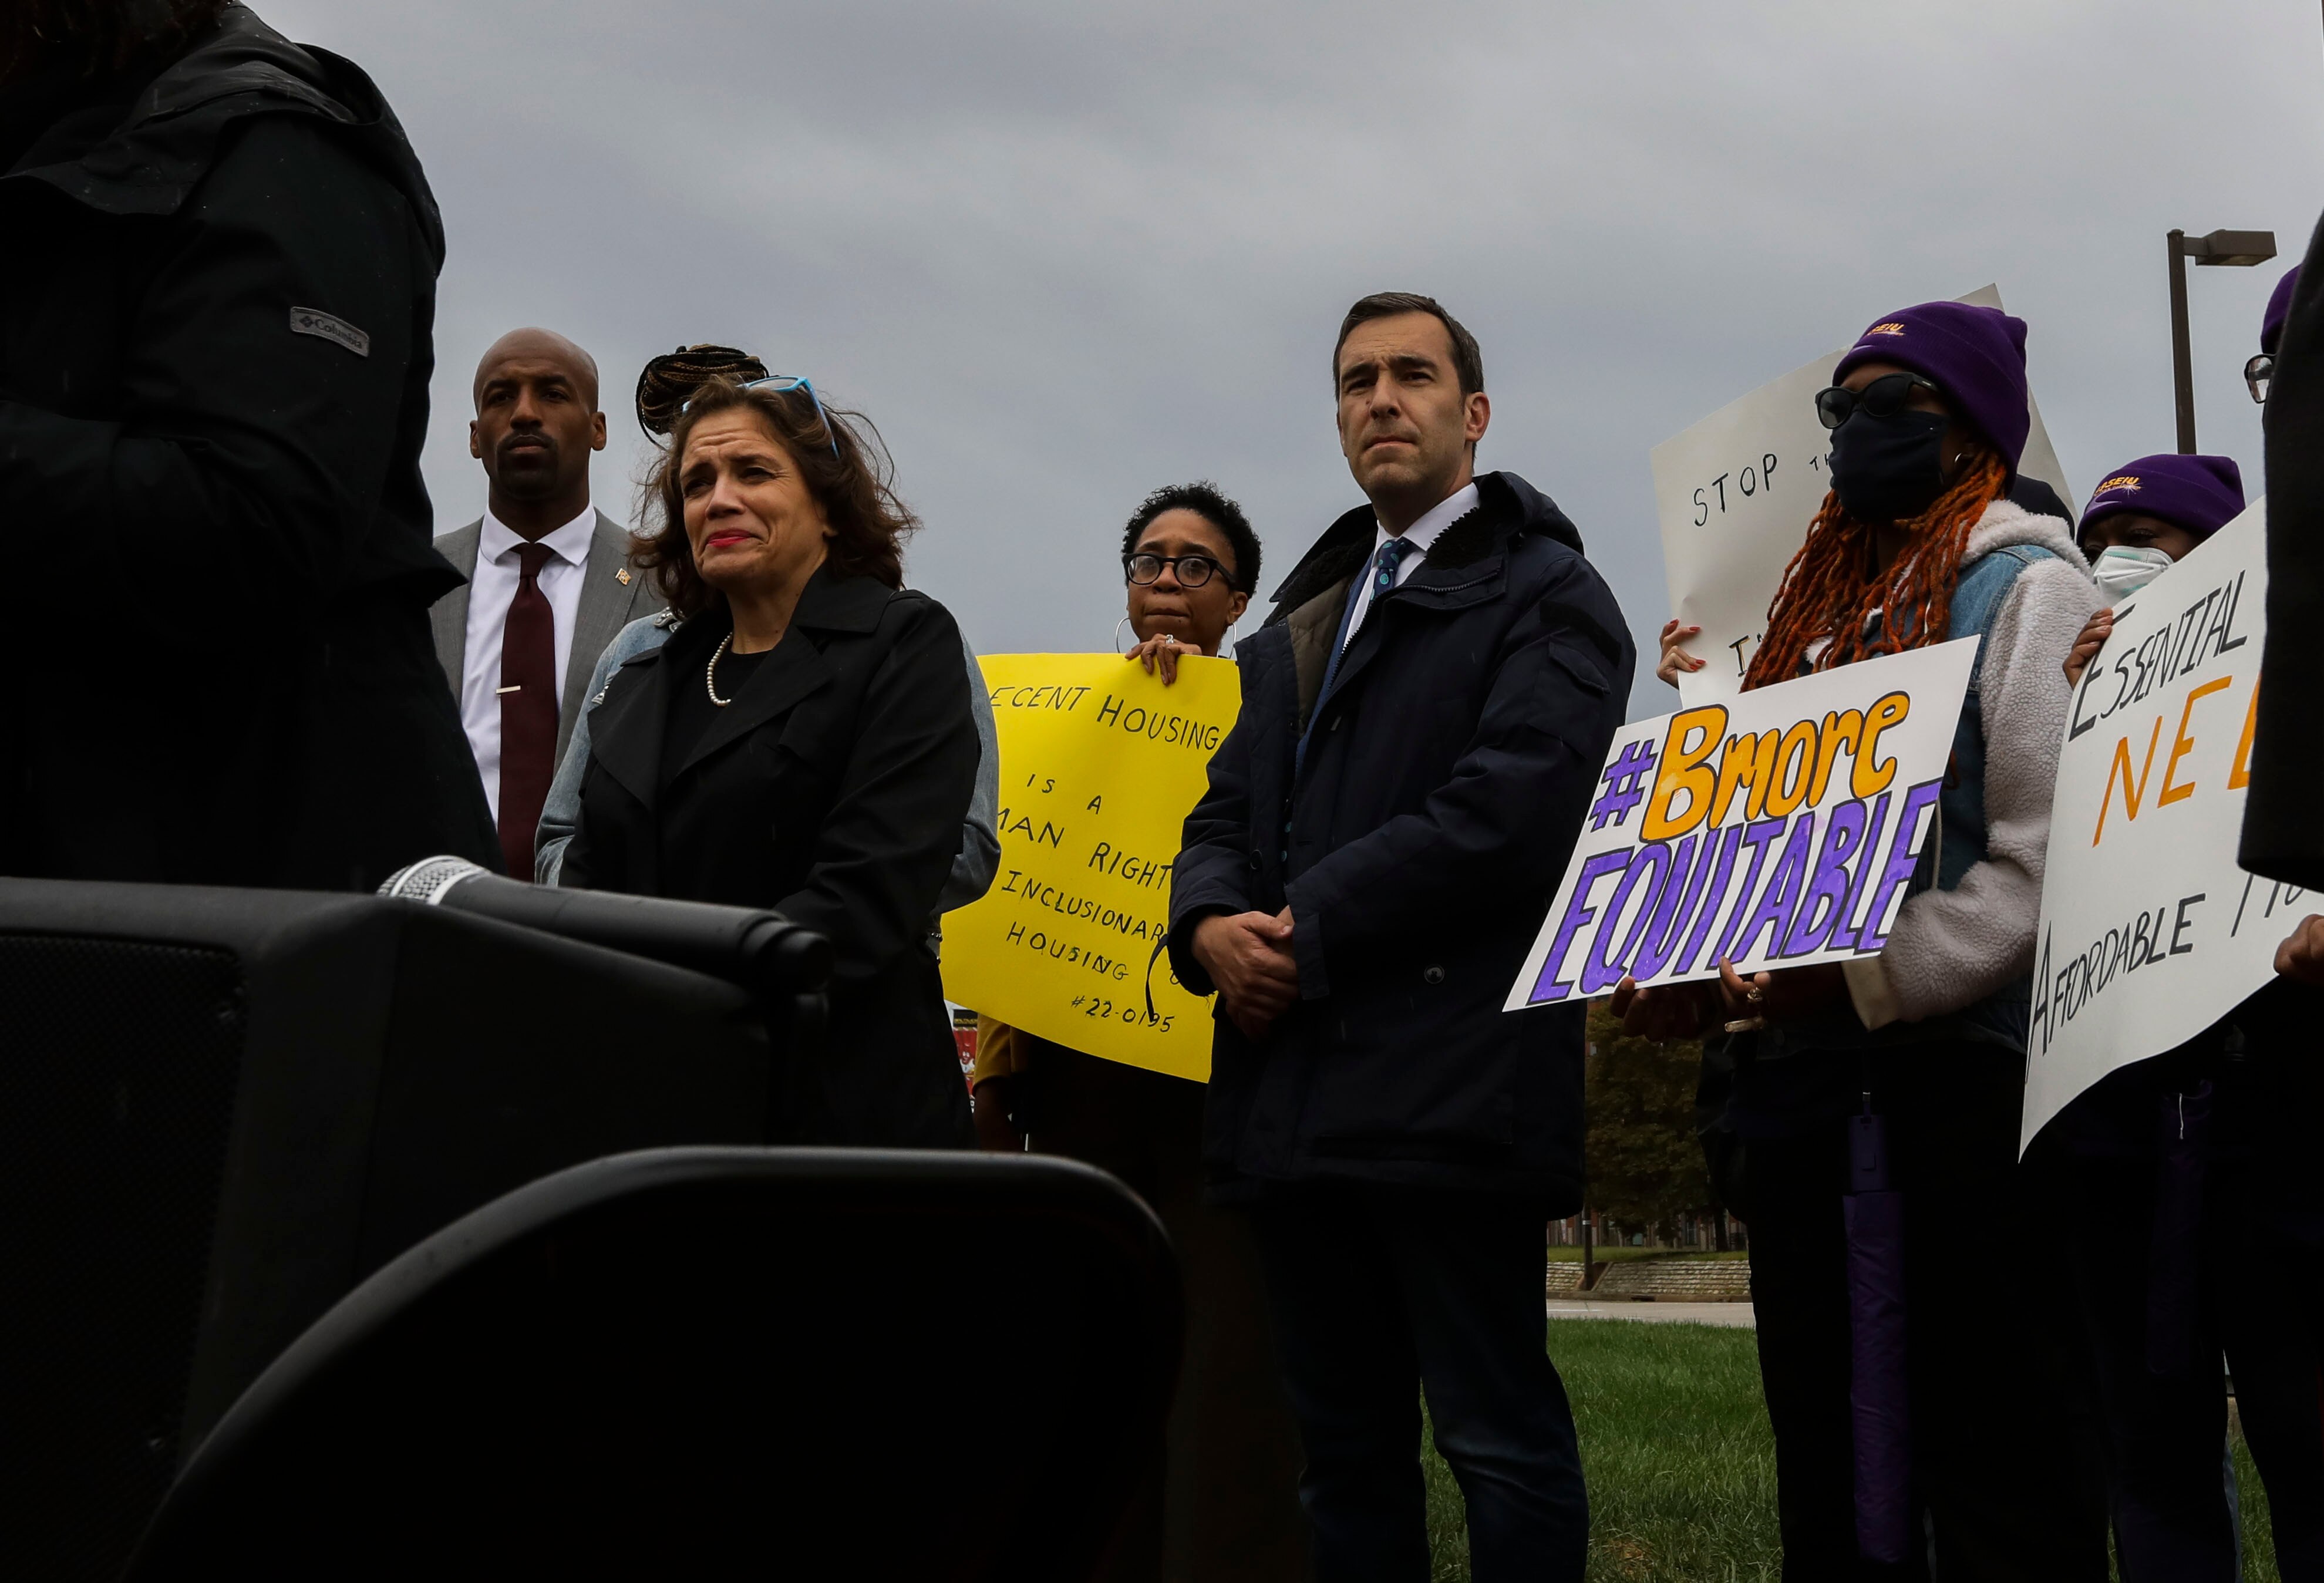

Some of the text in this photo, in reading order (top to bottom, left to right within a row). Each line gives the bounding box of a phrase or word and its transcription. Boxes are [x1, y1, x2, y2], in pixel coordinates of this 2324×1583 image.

[1693, 453, 1778, 527] STOP
[2069, 570, 2248, 743] ESSENTIAL
[990, 686, 1220, 750] ECENT HOUSING
[1026, 773, 1102, 814] IS A
[1087, 841, 1174, 890] RIGHT
[1527, 777, 1943, 1006] EQUITABLE
[1001, 870, 1165, 941] INCLUSIONAR
[1006, 921, 1129, 981] HOUSING
[2025, 892, 2206, 1084] AFFORDABLE
